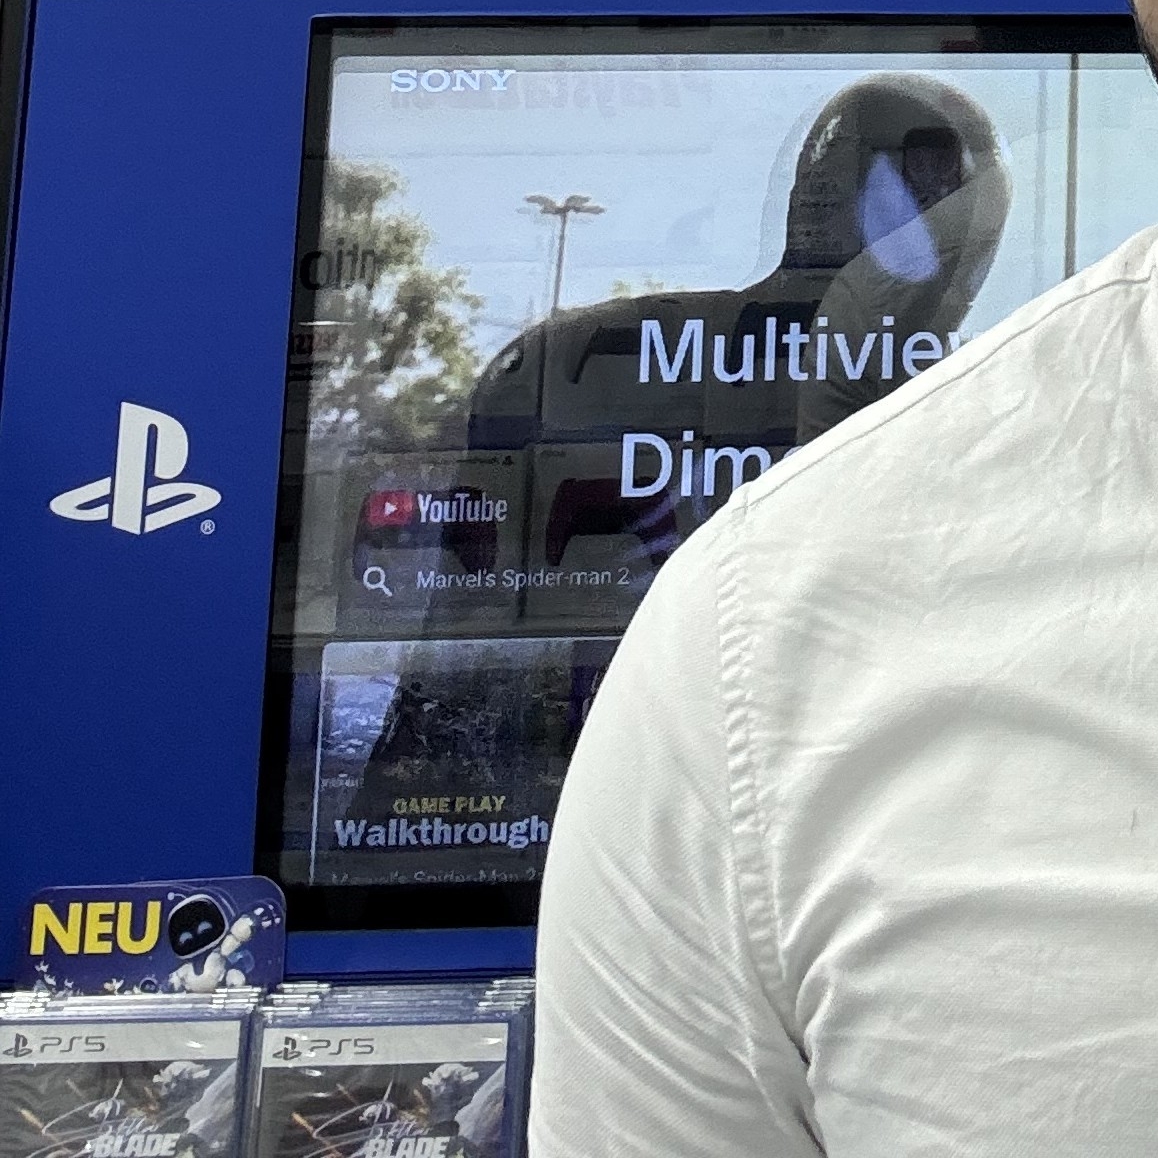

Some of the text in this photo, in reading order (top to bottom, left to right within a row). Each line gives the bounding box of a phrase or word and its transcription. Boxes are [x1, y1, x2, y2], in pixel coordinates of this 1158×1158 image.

[389, 69, 515, 92] SONY
[620, 430, 801, 498] Dim
[417, 493, 508, 523] YouTube
[416, 567, 630, 591] Marvel's Spider-man 2
[393, 795, 506, 814] GAME PLAY
[334, 815, 548, 849] Walkthrough
[30, 901, 162, 955] NEU
[40, 1036, 105, 1052] PS5
[310, 1038, 375, 1055] PS5
[93, 1133, 180, 1157] BLADE
[366, 1136, 450, 1158] BLADE
